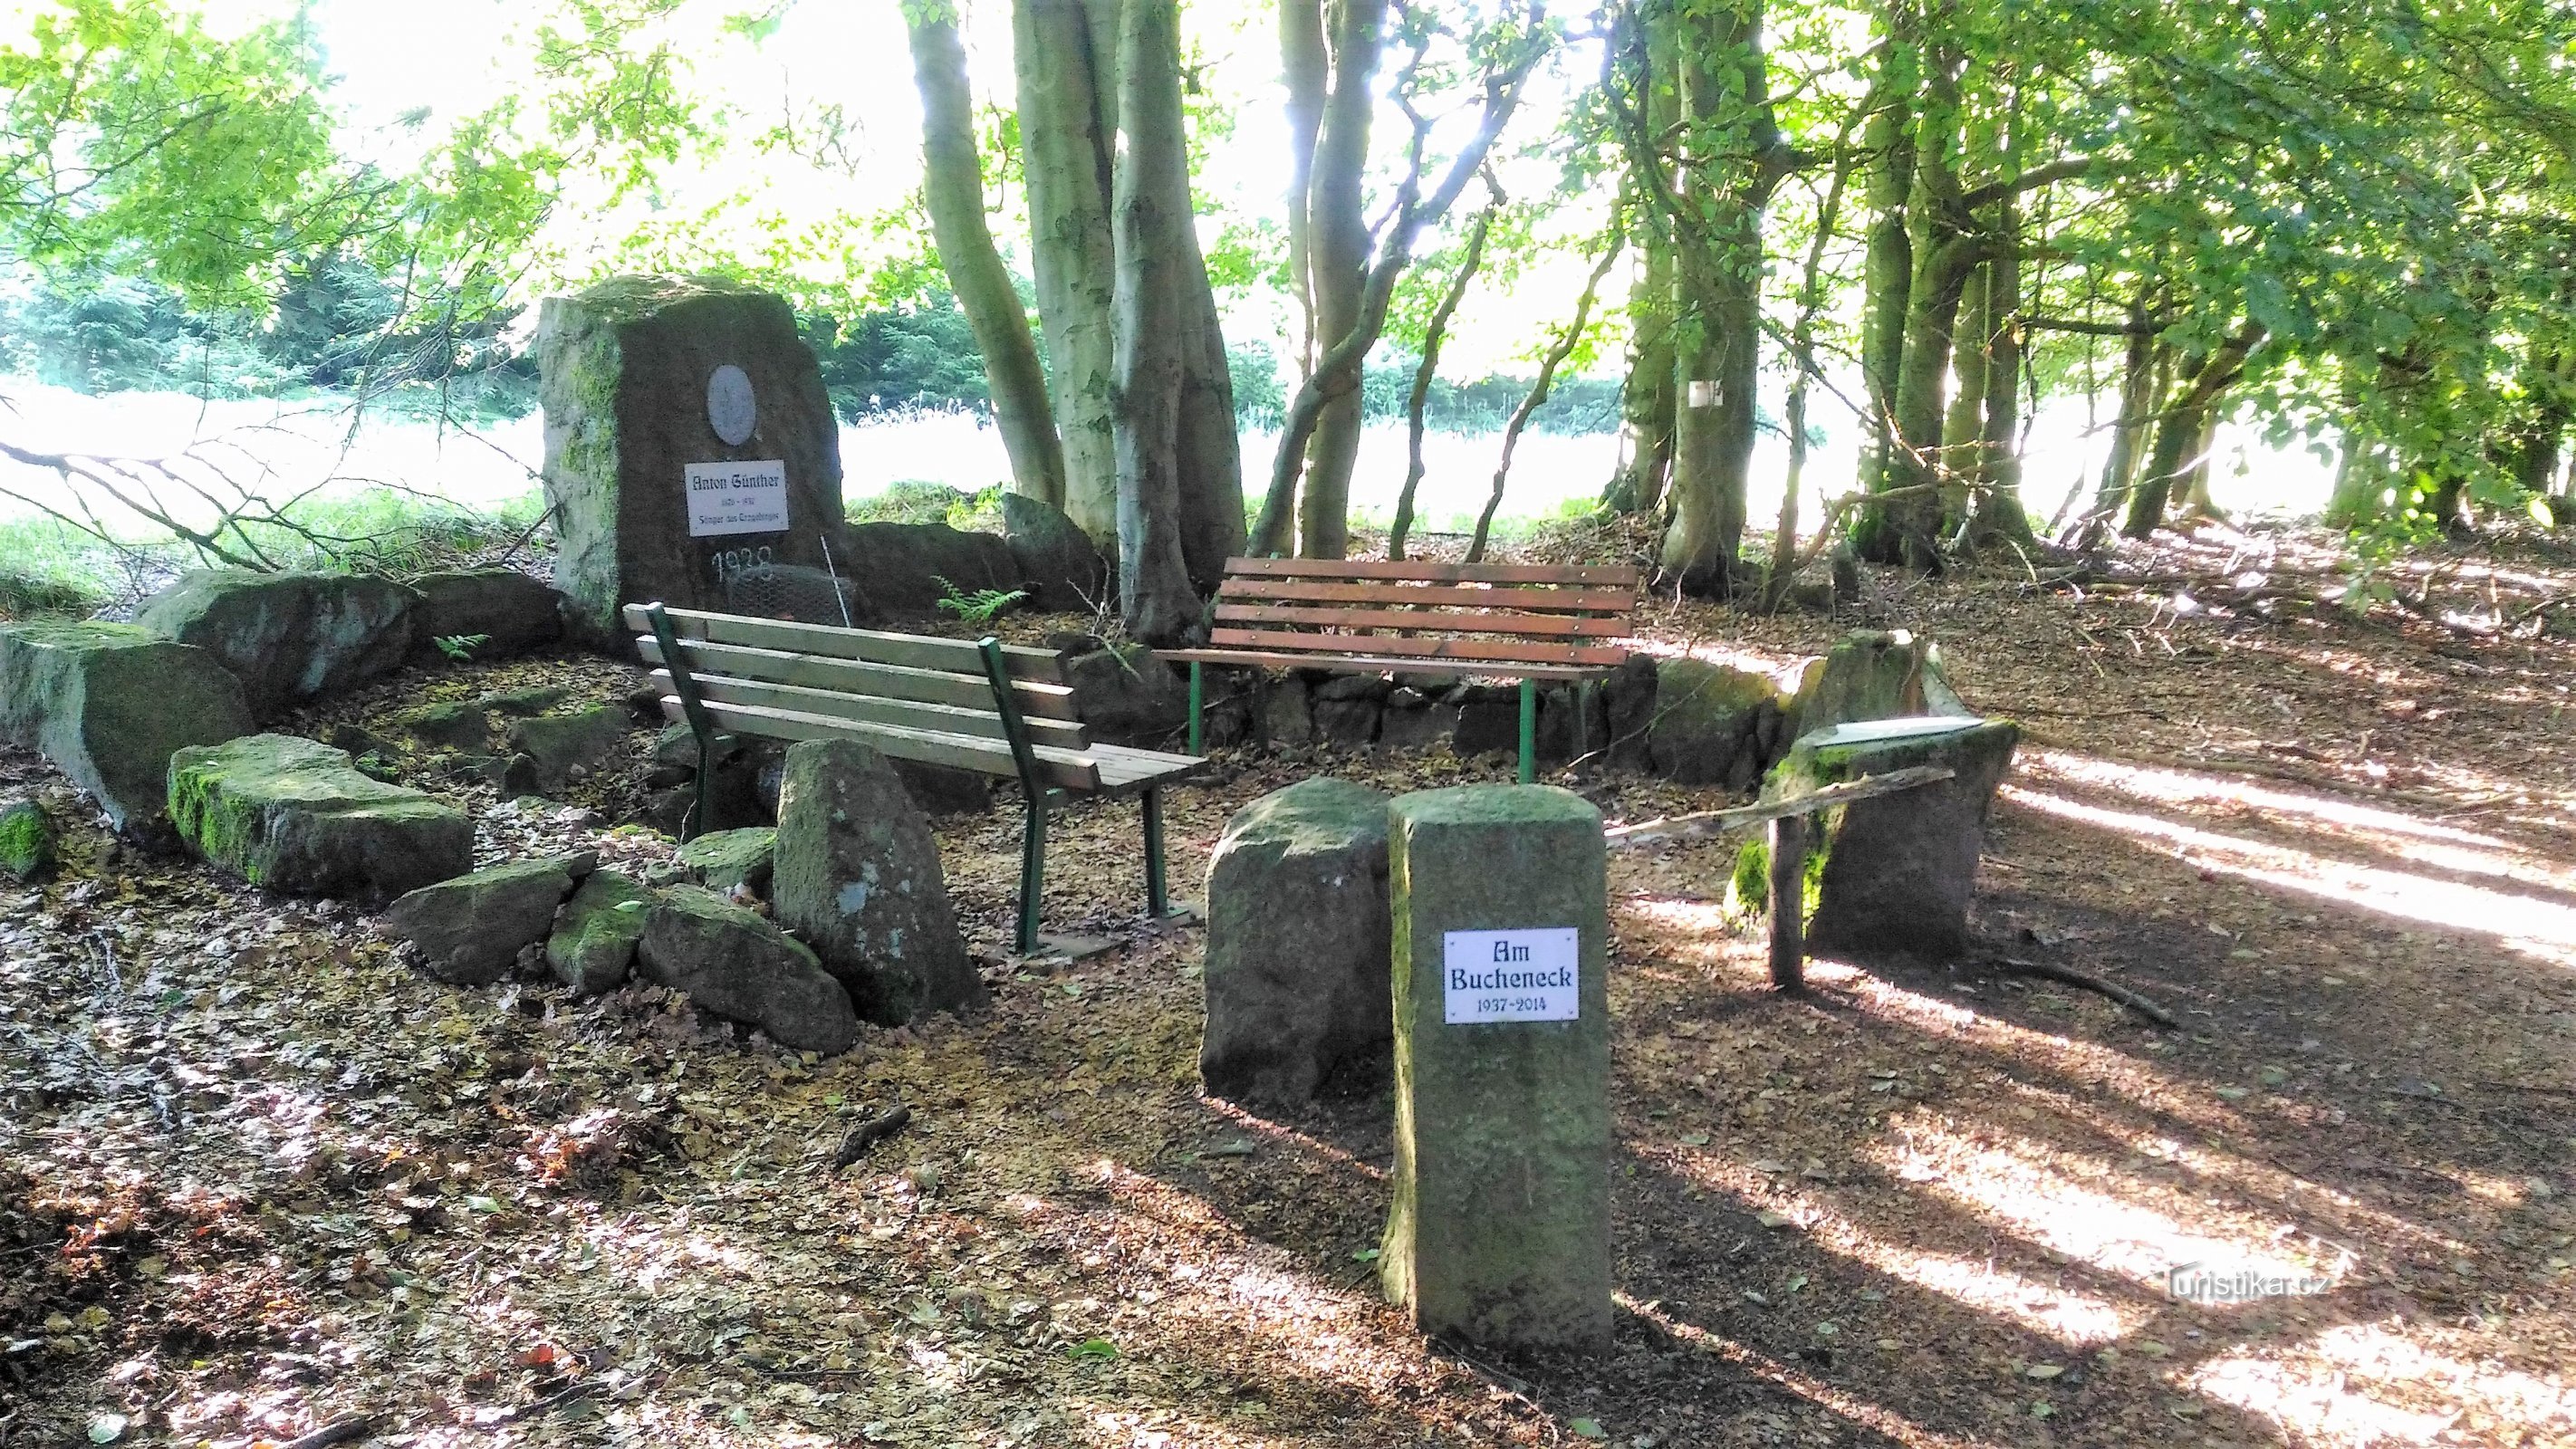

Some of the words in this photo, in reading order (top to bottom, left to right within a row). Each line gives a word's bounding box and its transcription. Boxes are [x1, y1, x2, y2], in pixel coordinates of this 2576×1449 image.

[693, 475, 727, 491] Anton
[732, 474, 779, 488] Günther
[1494, 940, 1530, 962] Am
[1451, 966, 1572, 990] Bucheneck
[1477, 997, 1547, 1012] 1937-2014
